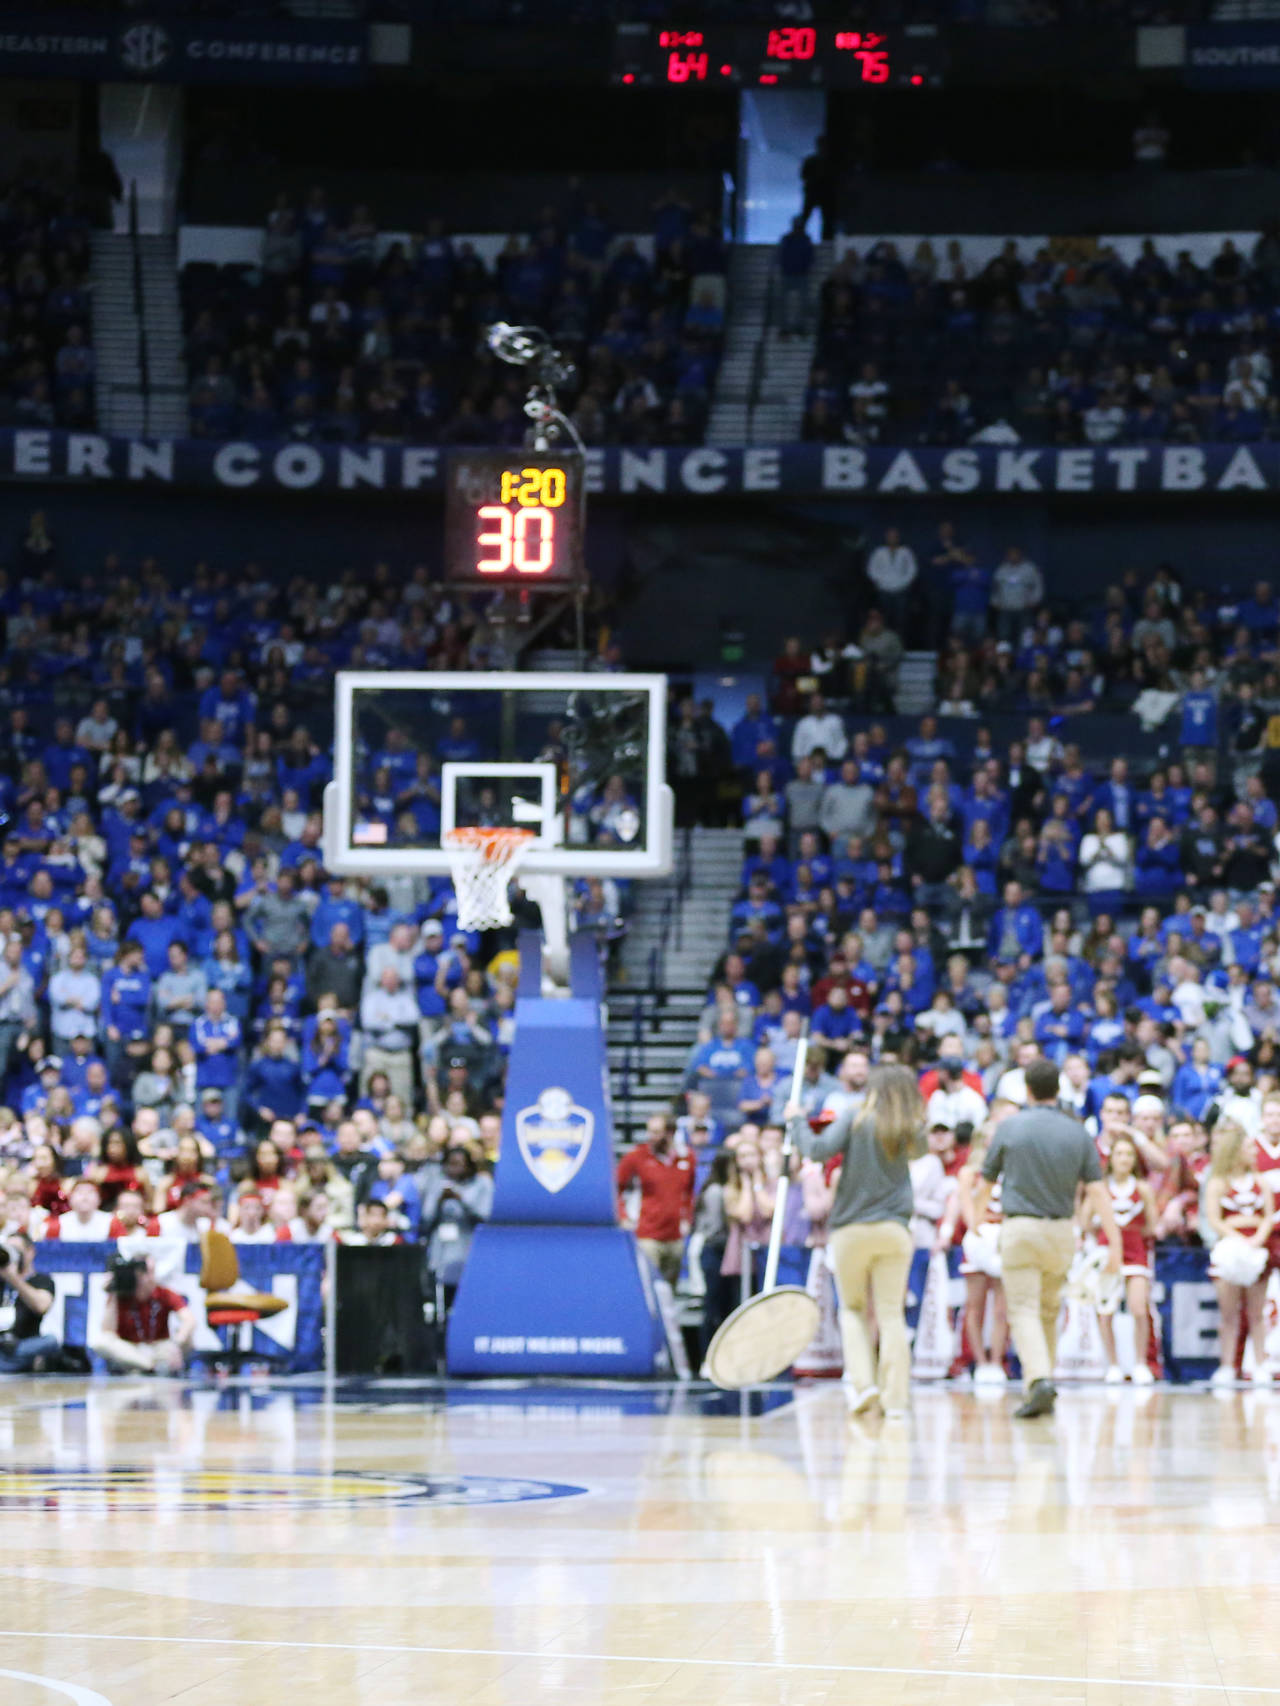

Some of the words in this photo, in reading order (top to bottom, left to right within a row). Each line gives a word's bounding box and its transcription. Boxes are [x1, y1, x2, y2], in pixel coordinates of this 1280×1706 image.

[186, 39, 361, 65] CONFERENCE
[212, 440, 781, 493] CONFENCE
[500, 468, 566, 508] 1:20
[476, 505, 555, 574] 30
